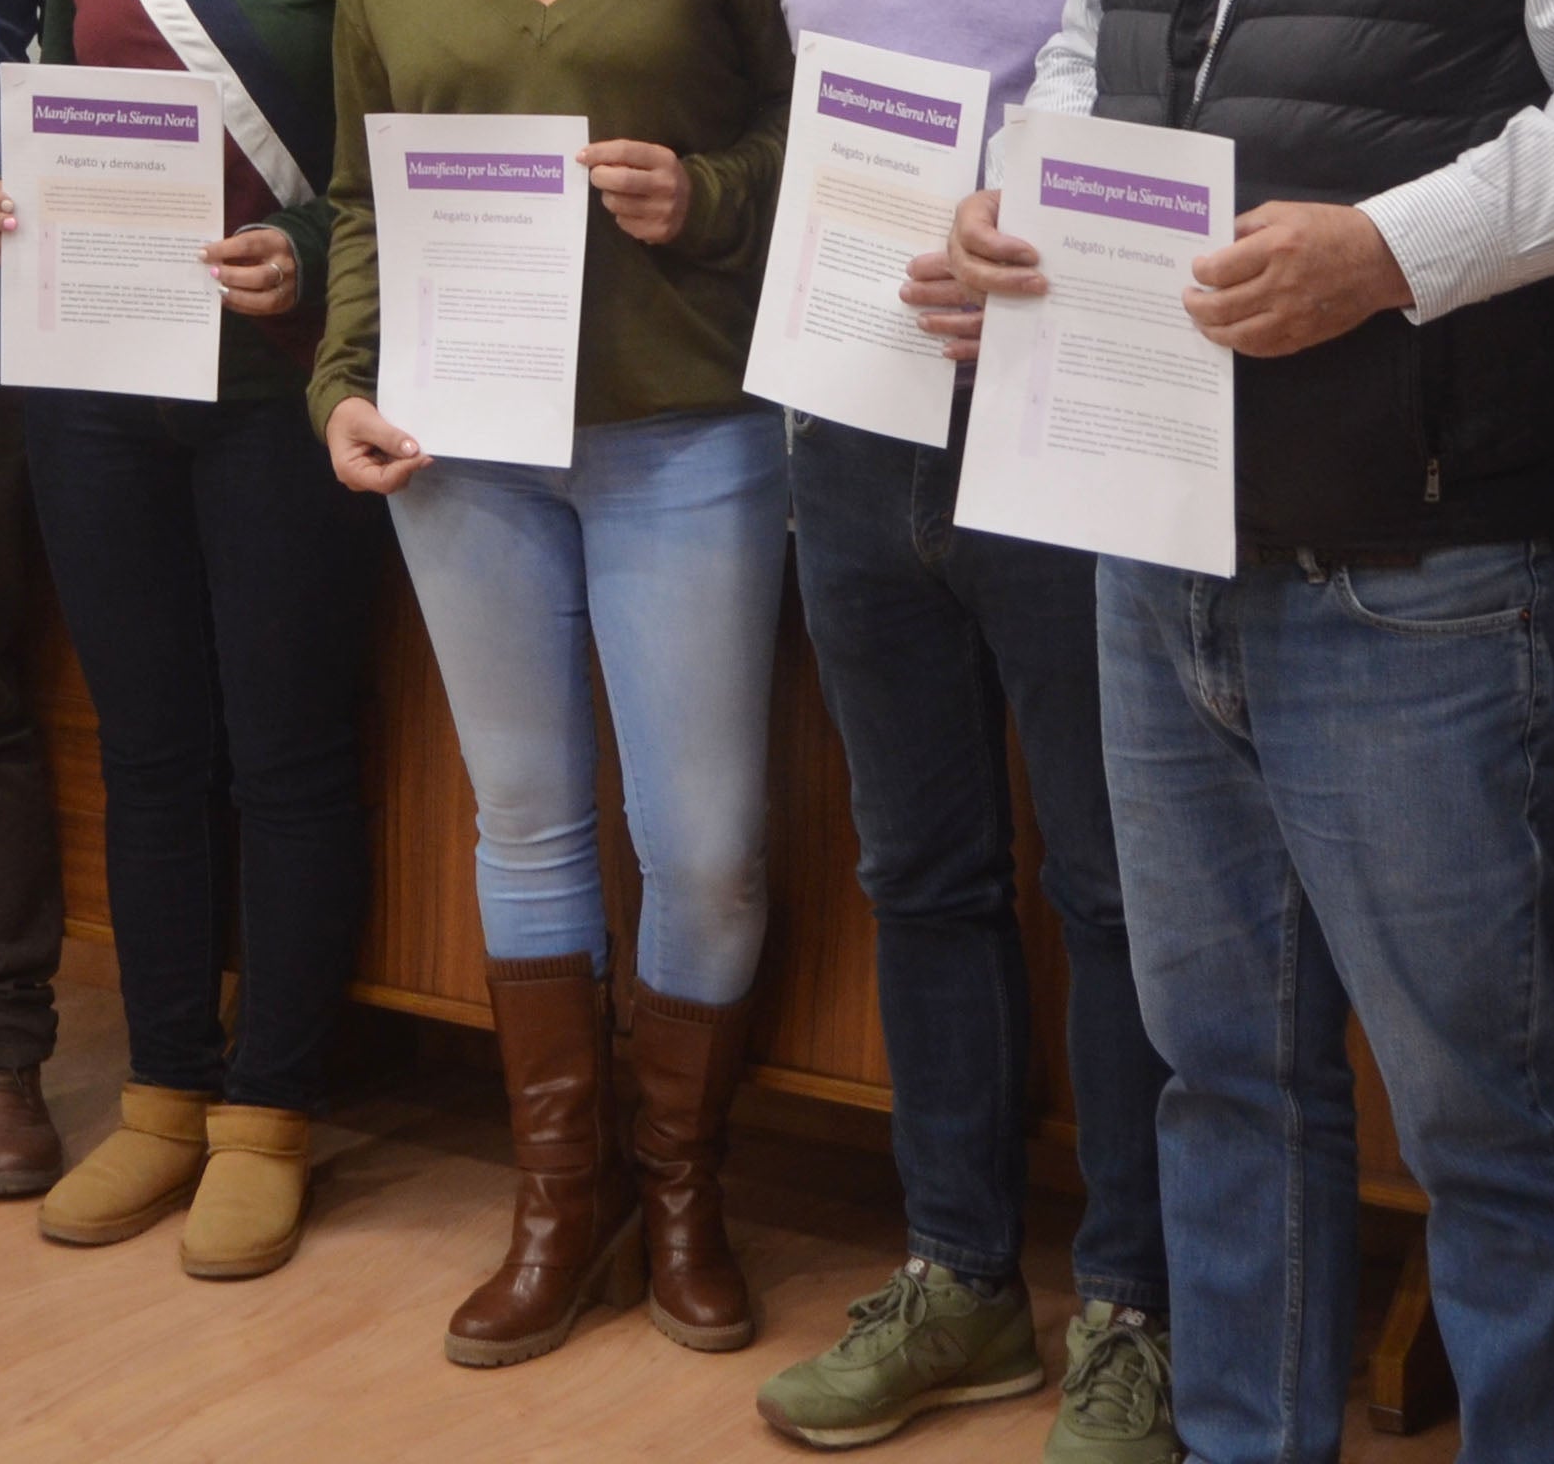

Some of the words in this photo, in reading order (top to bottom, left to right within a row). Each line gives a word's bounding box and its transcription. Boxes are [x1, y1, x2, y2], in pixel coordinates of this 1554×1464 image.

[35, 105, 95, 124] Manifiesto
[95, 111, 115, 126] por
[116, 109, 127, 123] la
[129, 110, 162, 126] Sierra
[163, 112, 196, 128] Norte
[820, 82, 869, 107] Manifiesto
[868, 98, 885, 113] por
[885, 98, 895, 115] la
[895, 102, 925, 122] Sierra
[925, 108, 958, 130] Norte
[56, 155, 98, 168] Alegato
[109, 158, 166, 171] demandas
[409, 161, 466, 179] Manifiesto
[467, 165, 486, 179] por
[487, 163, 497, 176] la
[498, 164, 530, 178] Sierra
[531, 164, 562, 179] Norte
[1043, 171, 1105, 197] Manifiesto
[1105, 186, 1126, 202] por
[1126, 185, 1137, 202] la
[1139, 188, 1173, 210] Sierra
[1175, 194, 1208, 216] Norte
